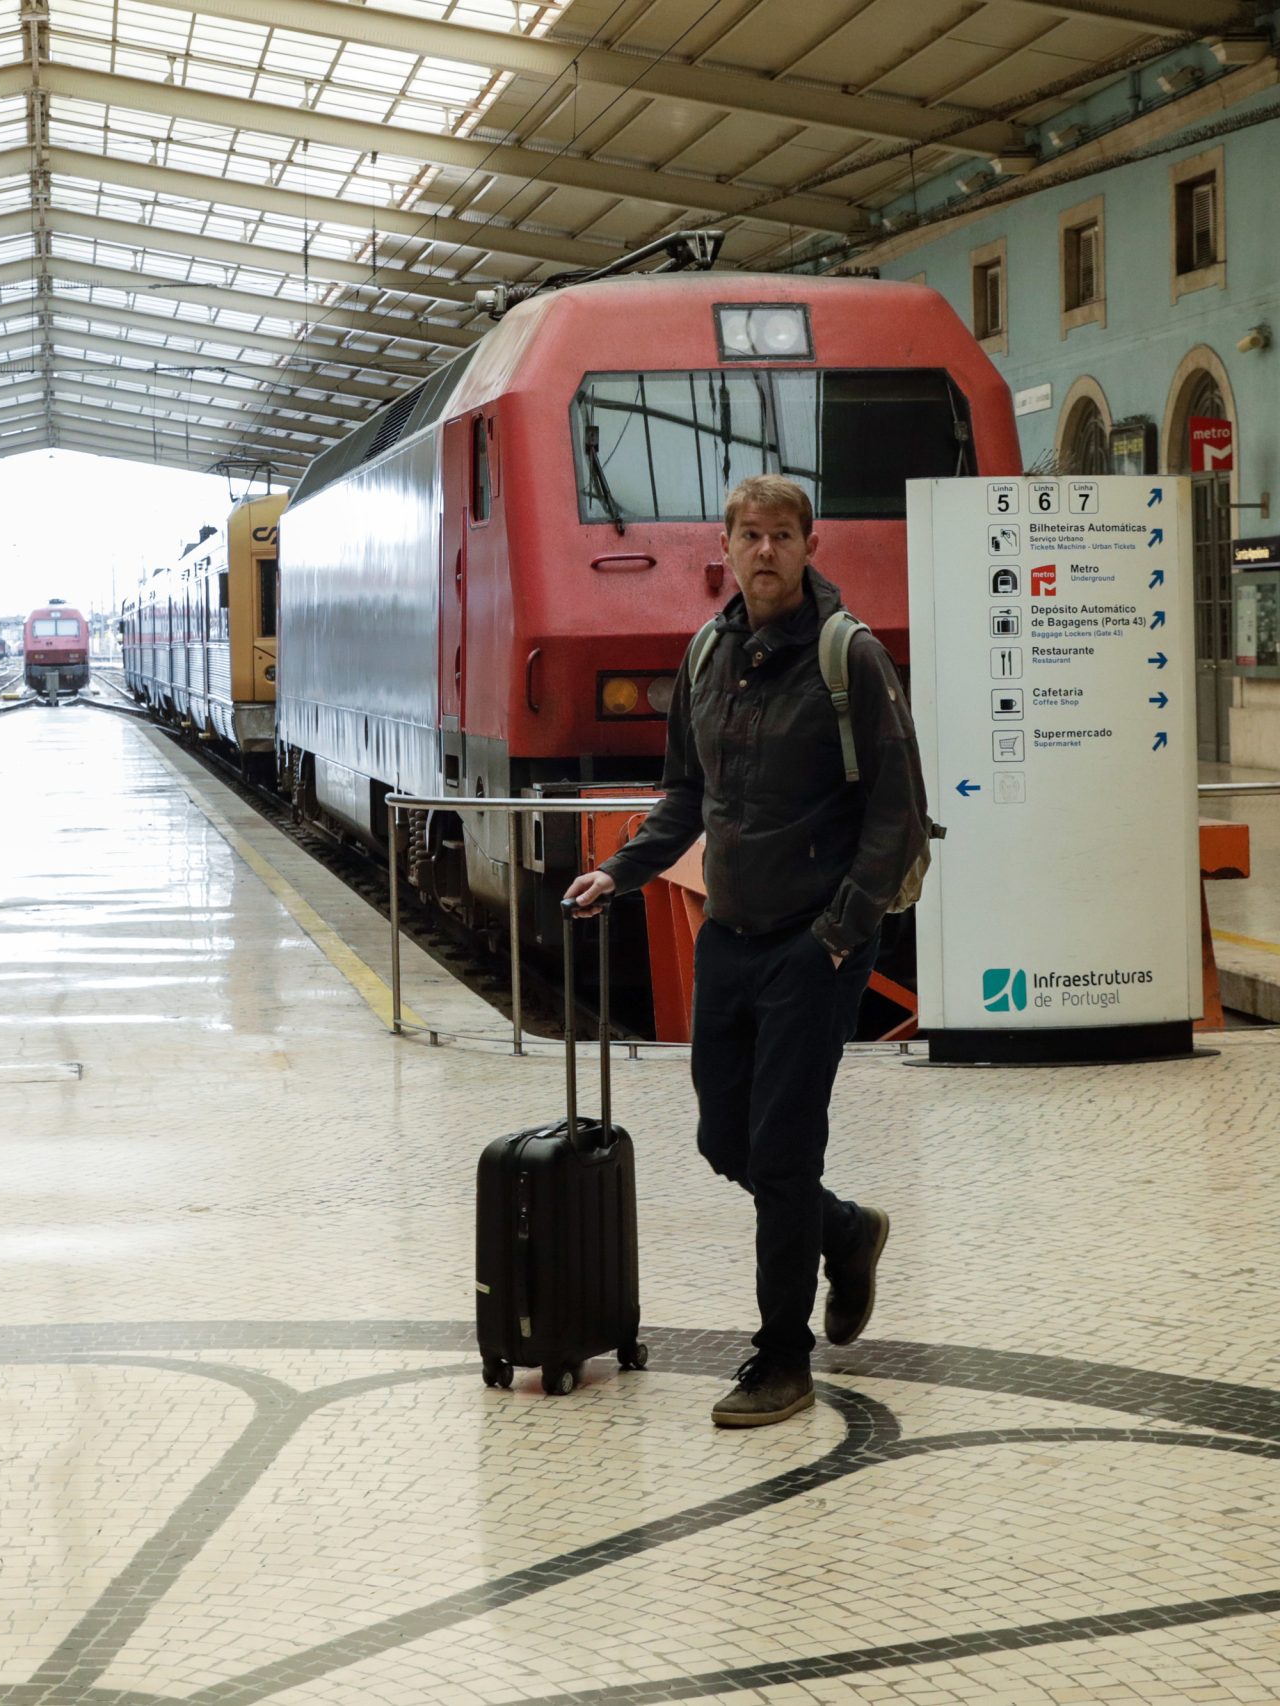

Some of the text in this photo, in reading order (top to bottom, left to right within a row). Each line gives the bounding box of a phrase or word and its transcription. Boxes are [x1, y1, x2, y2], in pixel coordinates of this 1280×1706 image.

[1193, 428, 1231, 440] metro
[991, 484, 1014, 493] Linha
[1032, 483, 1054, 492] Linha
[1073, 483, 1094, 492] Linha
[997, 494, 1010, 512] 5
[1038, 492, 1052, 511] 6
[1078, 493, 1090, 511] 7
[1029, 522, 1148, 533] Bilheteiras Automáticas
[1029, 535, 1084, 544] Serviço Urbano
[1030, 543, 1055, 551] Tickets
[1113, 542, 1136, 550] Tickets
[1070, 564, 1100, 574] Metro
[1070, 574, 1116, 583] Underground
[1031, 603, 1136, 616] Depósito Automático
[1031, 616, 1147, 629] de Bagagens (Porta 43)
[1031, 630, 1063, 639] Baggage
[1064, 630, 1092, 638] Lockers
[1093, 629, 1111, 638] (Gate
[1032, 645, 1095, 656] Restaurante
[1032, 656, 1072, 664] Restaurant
[1032, 687, 1084, 697] Cafetaria
[1032, 698, 1080, 708] Coffee Shop
[1033, 727, 1113, 741] Supermercado
[1033, 739, 1082, 749] Supermarket
[1034, 970, 1153, 988] Infraestruturas
[1034, 989, 1121, 1009] de Portugal
